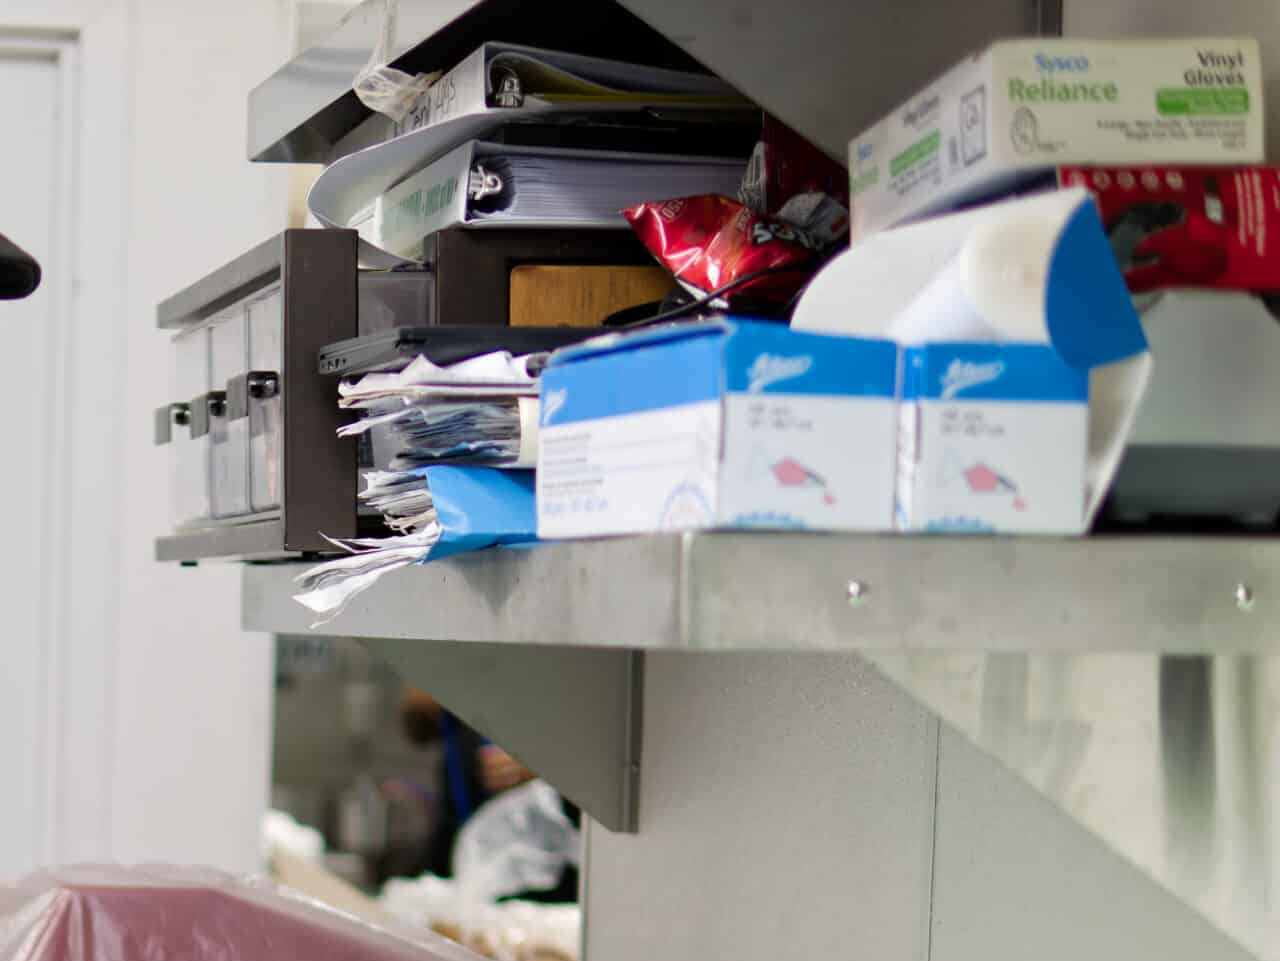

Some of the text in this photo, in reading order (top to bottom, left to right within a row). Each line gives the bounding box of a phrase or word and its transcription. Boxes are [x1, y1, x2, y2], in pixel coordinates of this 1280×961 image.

[1196, 51, 1245, 70] Vinyl
[1183, 69, 1246, 87] Gloves
[1008, 78, 1119, 103] Reliance
